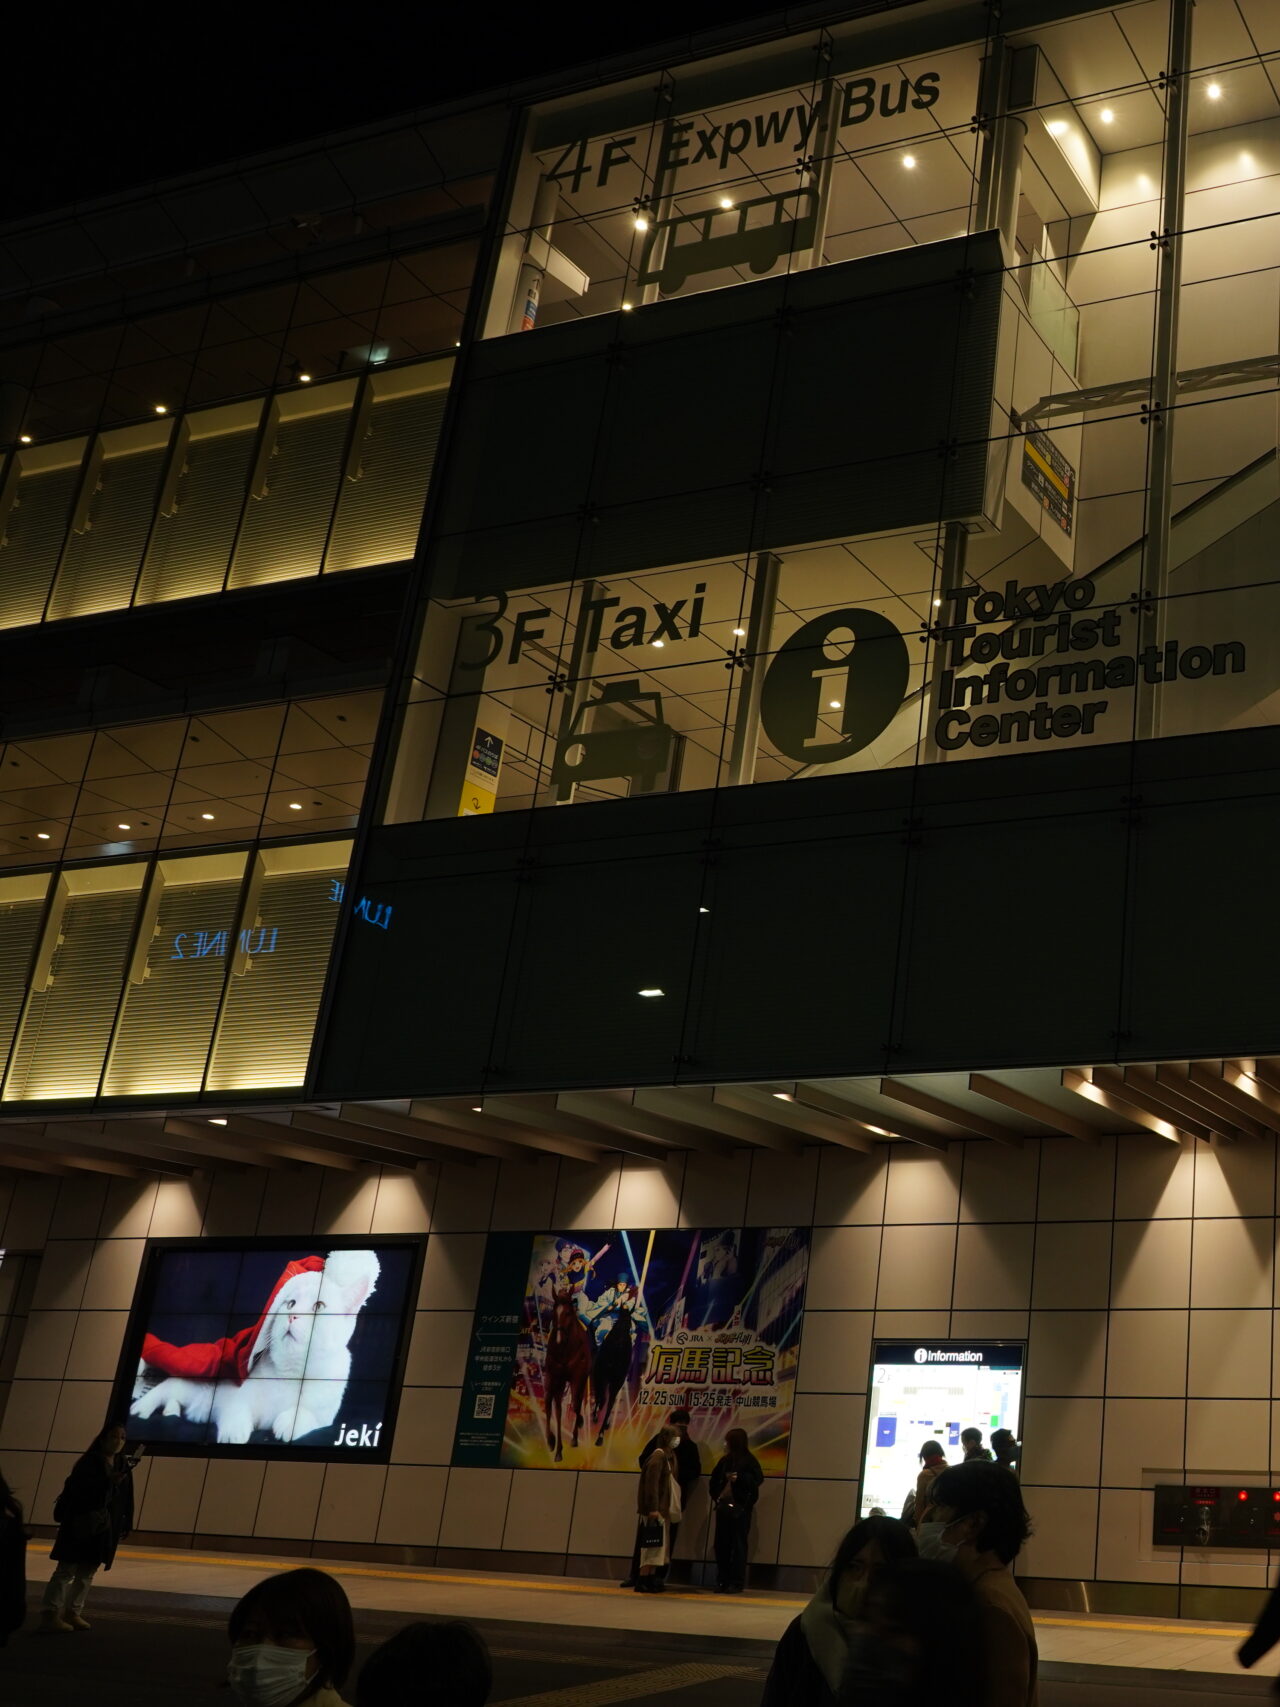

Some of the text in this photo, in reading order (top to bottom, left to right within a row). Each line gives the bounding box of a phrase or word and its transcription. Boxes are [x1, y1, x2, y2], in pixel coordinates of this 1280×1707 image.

[545, 134, 636, 194] 4F
[840, 71, 940, 127] Bus
[946, 577, 1095, 625] Tokyo
[460, 582, 707, 671] 3F Taxi
[942, 610, 1121, 666] Tourist
[938, 640, 1246, 709] Information
[934, 701, 1108, 751] Center
[689, 1334, 704, 1342] JRA
[928, 1350, 983, 1363] Information
[645, 1345, 775, 1386] 有馬記念
[638, 1390, 668, 1406] 12.25
[669, 1395, 685, 1406] SUN
[334, 1421, 383, 1447] jeki
